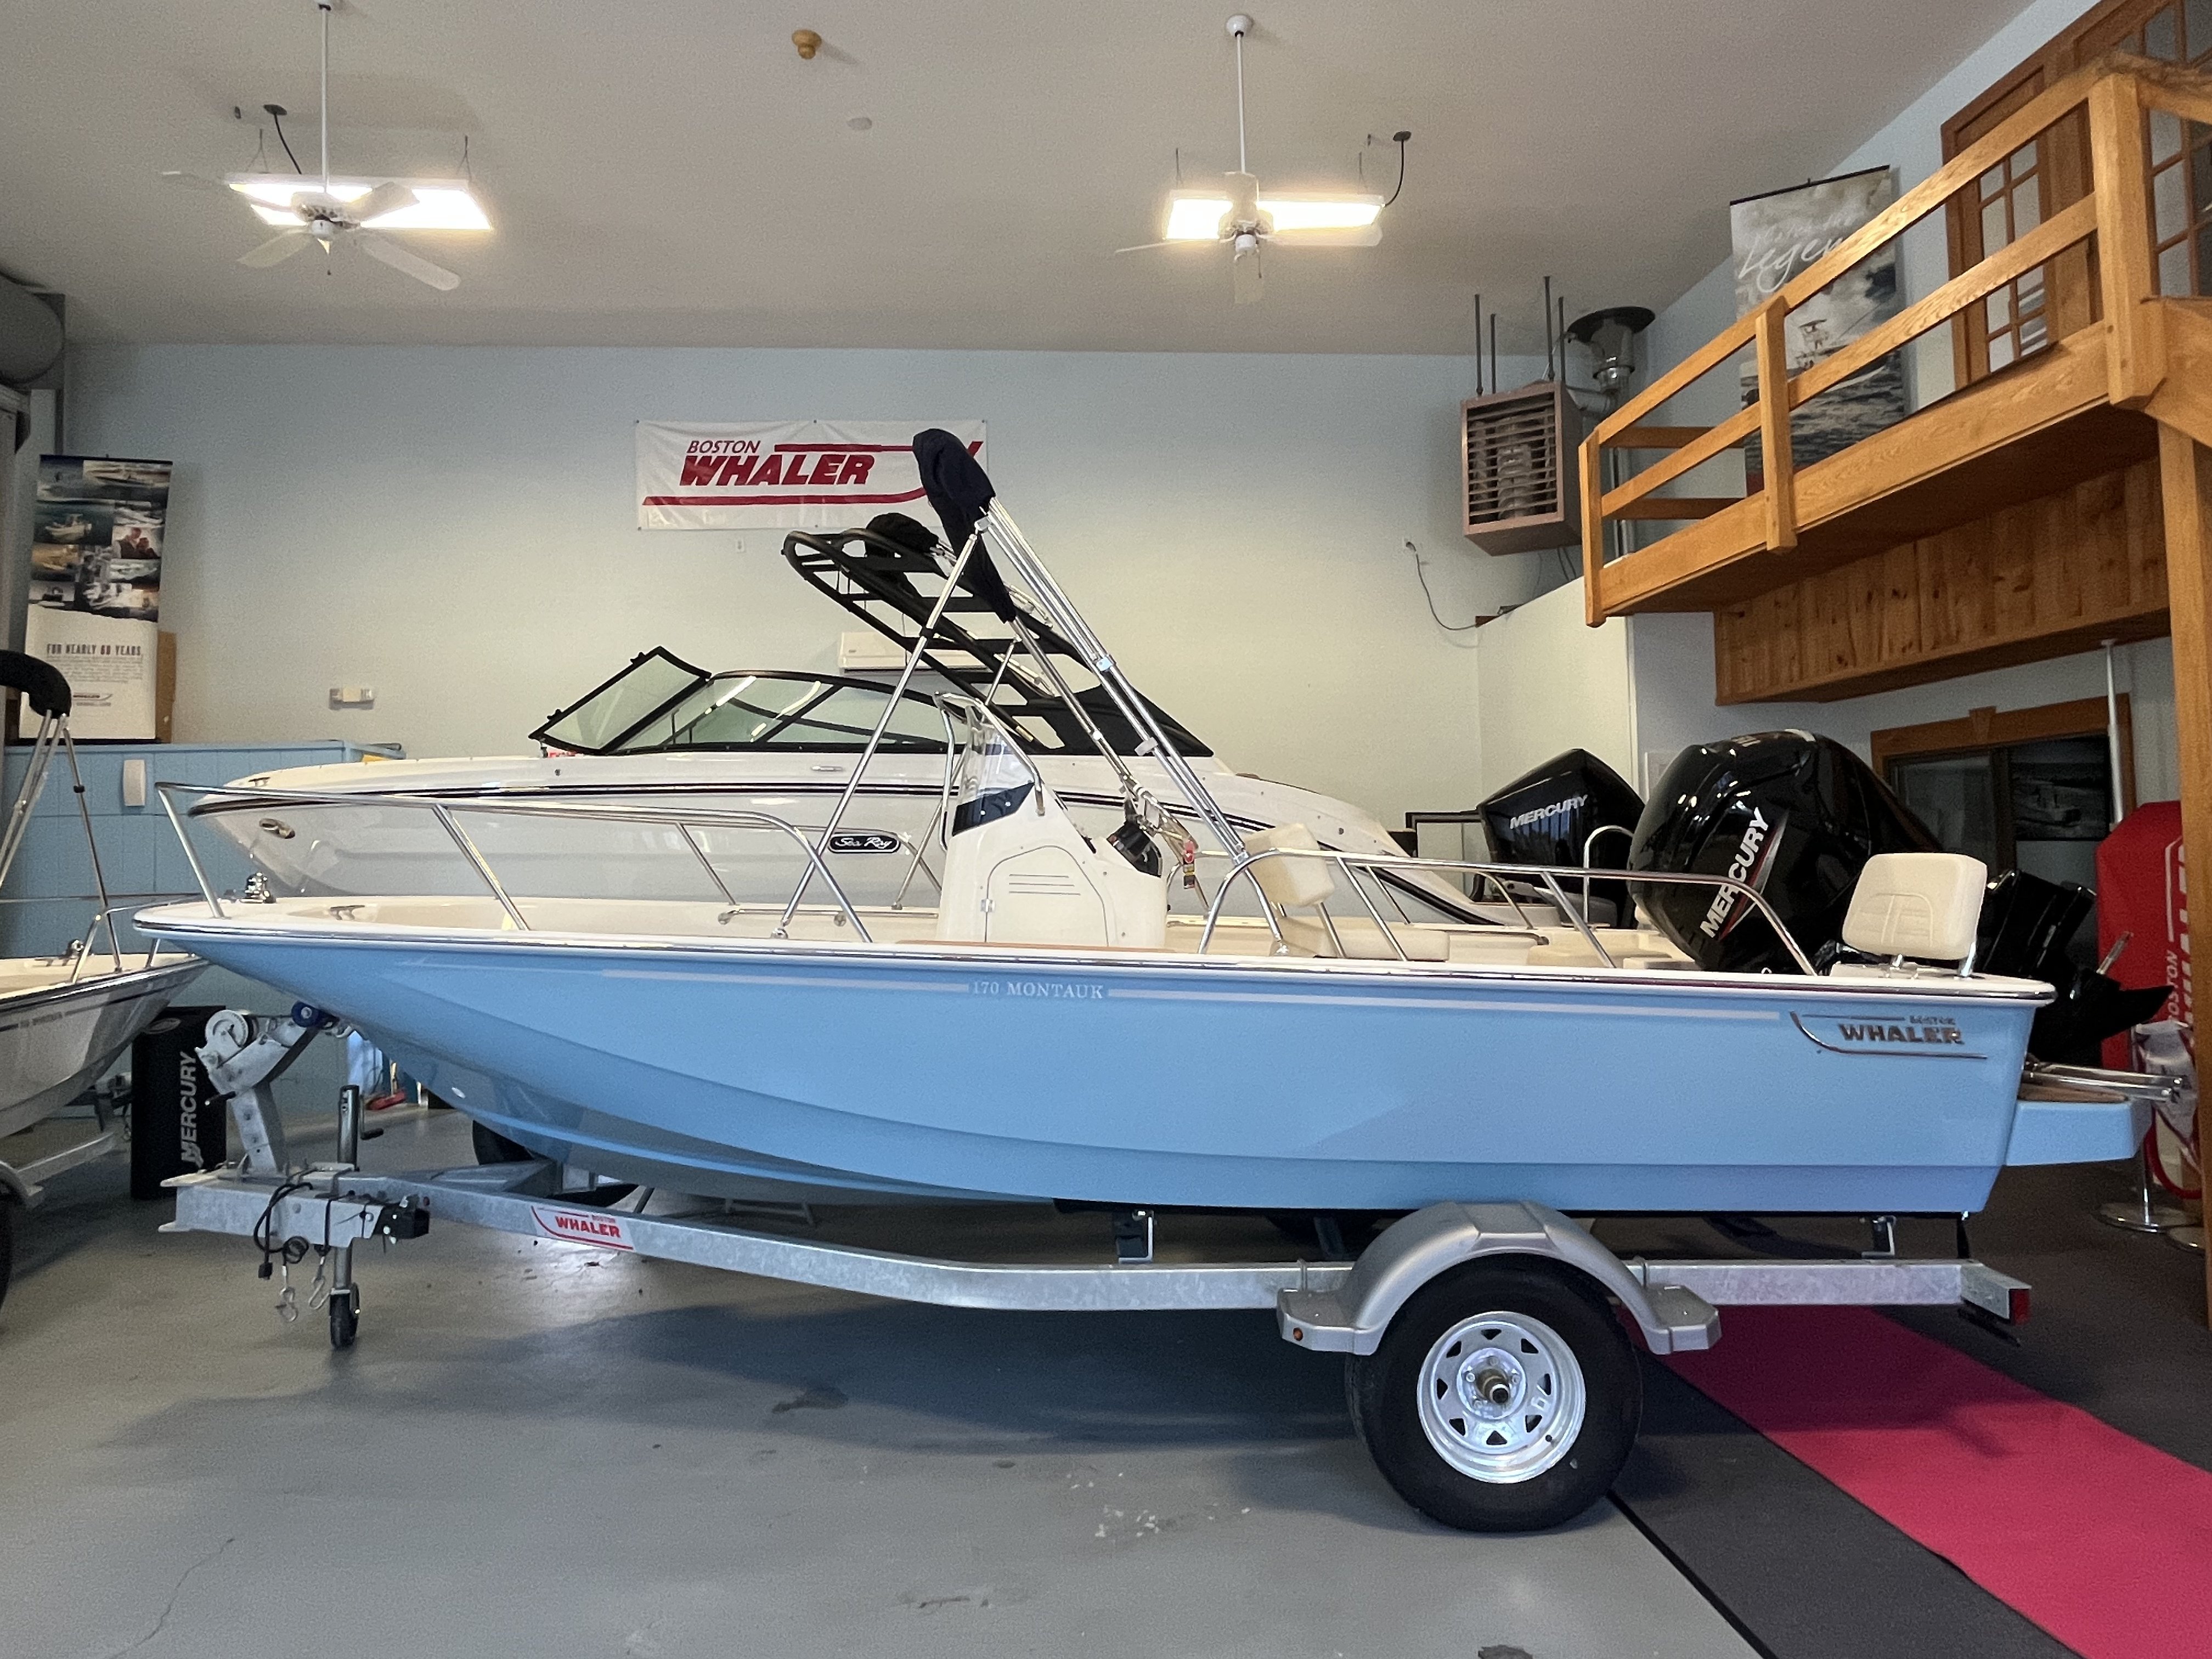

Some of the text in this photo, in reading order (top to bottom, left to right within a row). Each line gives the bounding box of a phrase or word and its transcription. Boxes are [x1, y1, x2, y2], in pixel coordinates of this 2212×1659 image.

[686, 440, 761, 454] BOSTON
[679, 454, 875, 486] WHALER
[47, 644, 61, 654] FOR
[65, 644, 97, 654] NEARLY
[1510, 794, 1588, 830] MERCURY
[1700, 806, 1769, 938] MERCURY
[973, 981, 1103, 999] 170 MONTAUK
[2166, 950, 2180, 1019] OSTON
[1838, 1023, 1965, 1045] WHALER
[180, 1051, 204, 1169] MERCURY
[555, 1215, 621, 1239] WHALER
